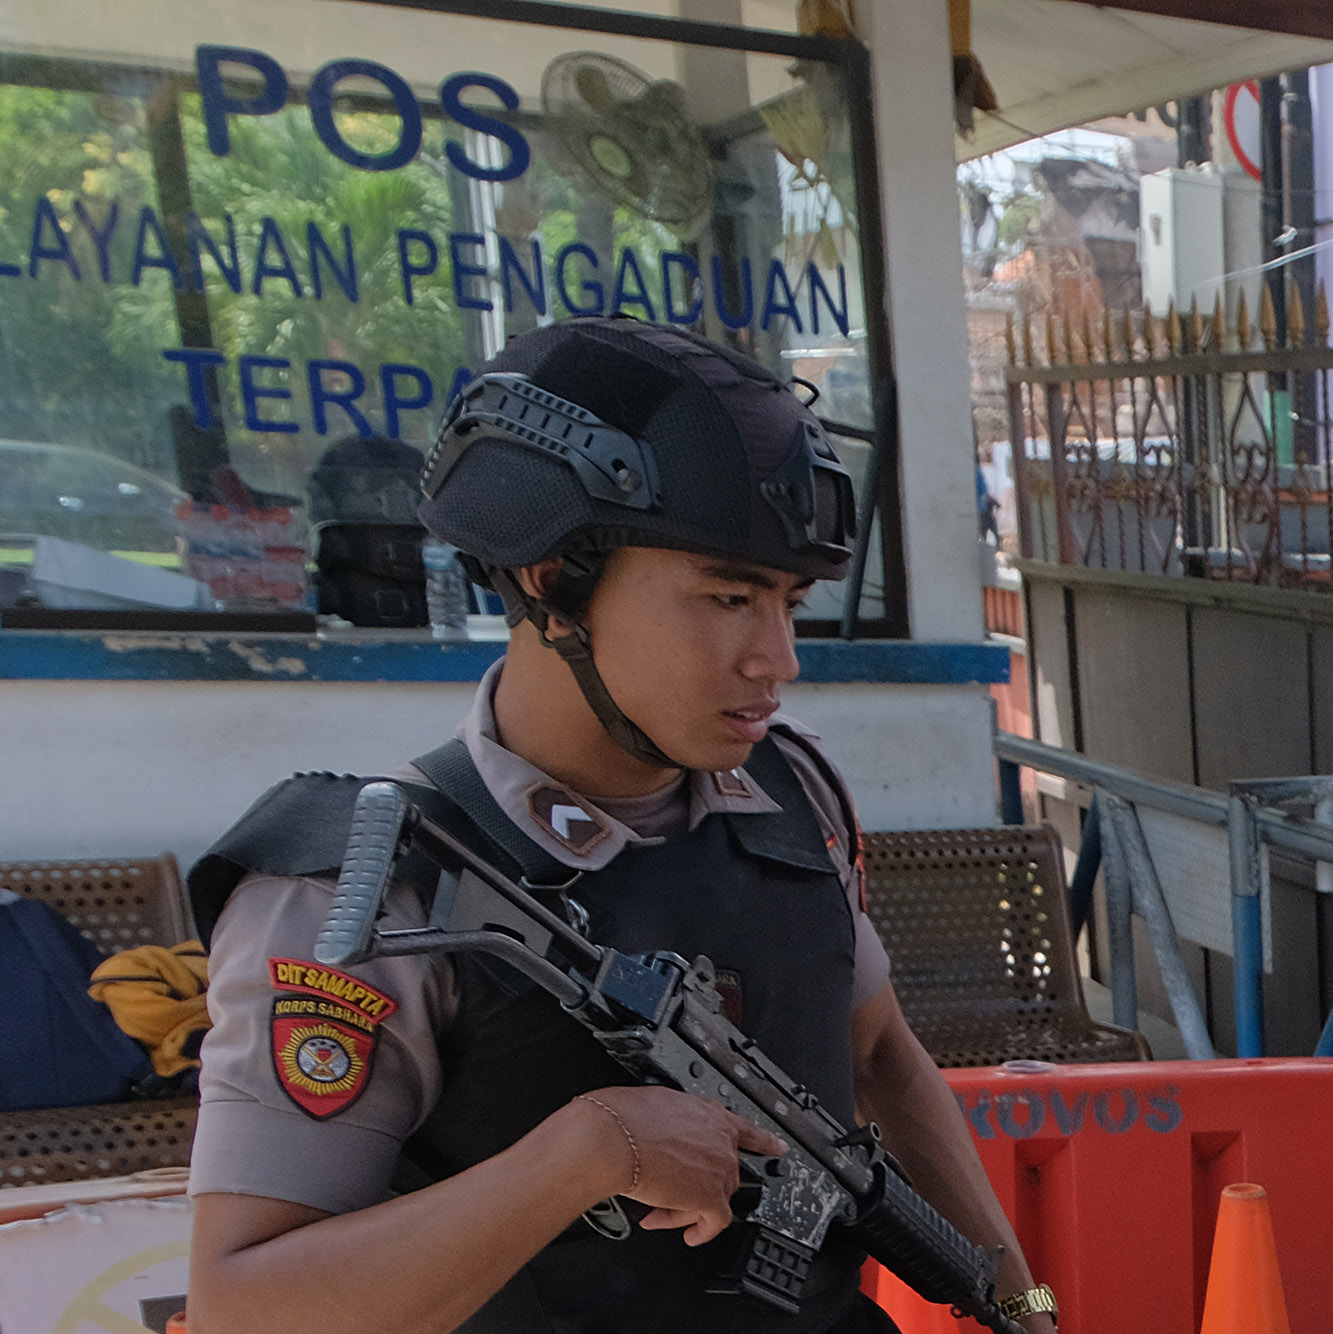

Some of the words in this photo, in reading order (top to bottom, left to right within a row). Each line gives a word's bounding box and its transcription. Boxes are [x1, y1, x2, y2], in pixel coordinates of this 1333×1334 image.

[195, 44, 531, 182] POS
[401, 229, 850, 338] PENGADUAN
[276, 1000, 317, 1015] KORPS
[277, 963, 306, 985] DIT
[304, 969, 386, 1016] SAMAPTA
[954, 1084, 1183, 1139] ROVOS
